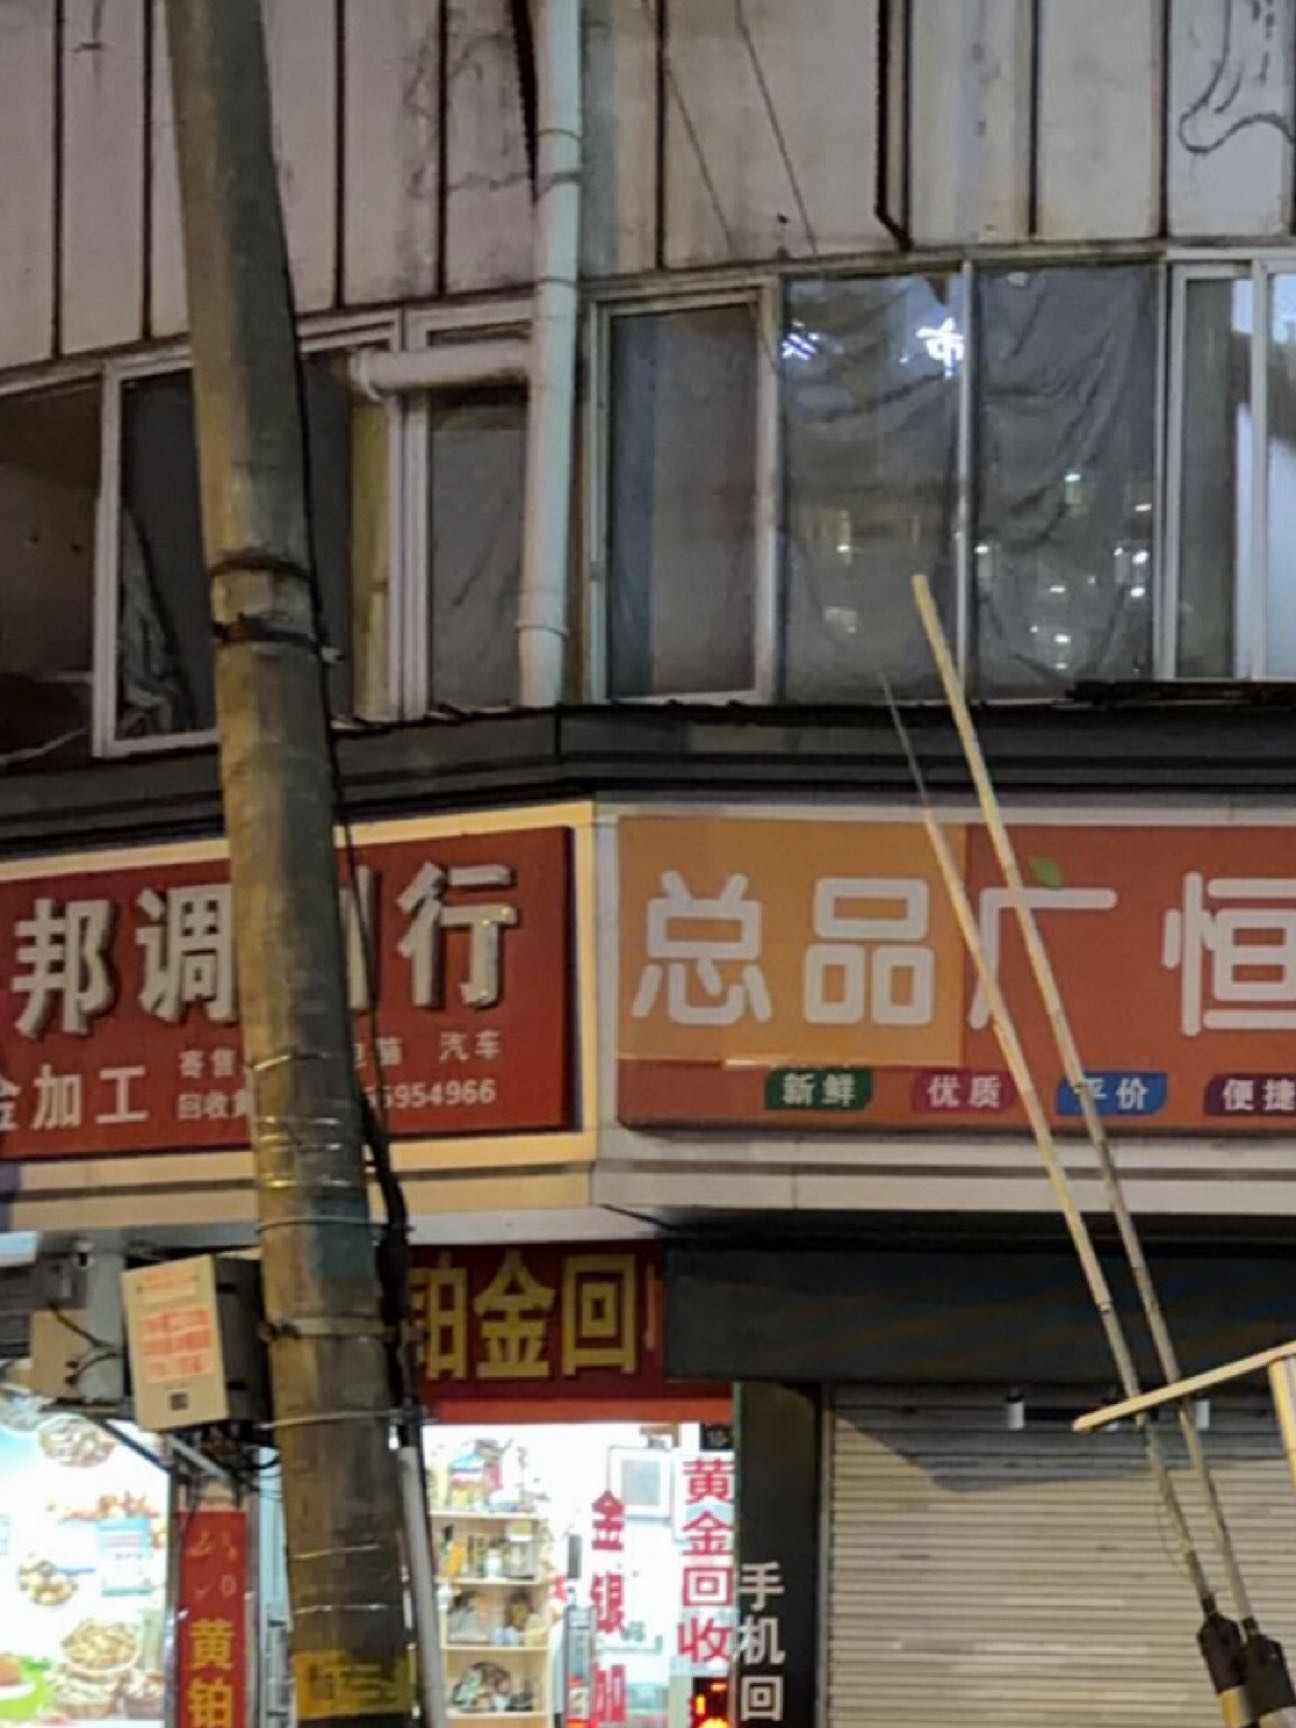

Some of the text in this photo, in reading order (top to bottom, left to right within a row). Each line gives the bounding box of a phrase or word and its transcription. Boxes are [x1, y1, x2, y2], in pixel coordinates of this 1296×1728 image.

[439, 1030, 499, 1062] 汽车
[781, 1072, 856, 1106] 新鲜
[927, 1074, 1002, 1108] 优质
[1223, 1079, 1296, 1111] 便捷
[410, 1250, 654, 1380] 铂金回
[678, 1457, 736, 1663] 黄金回收
